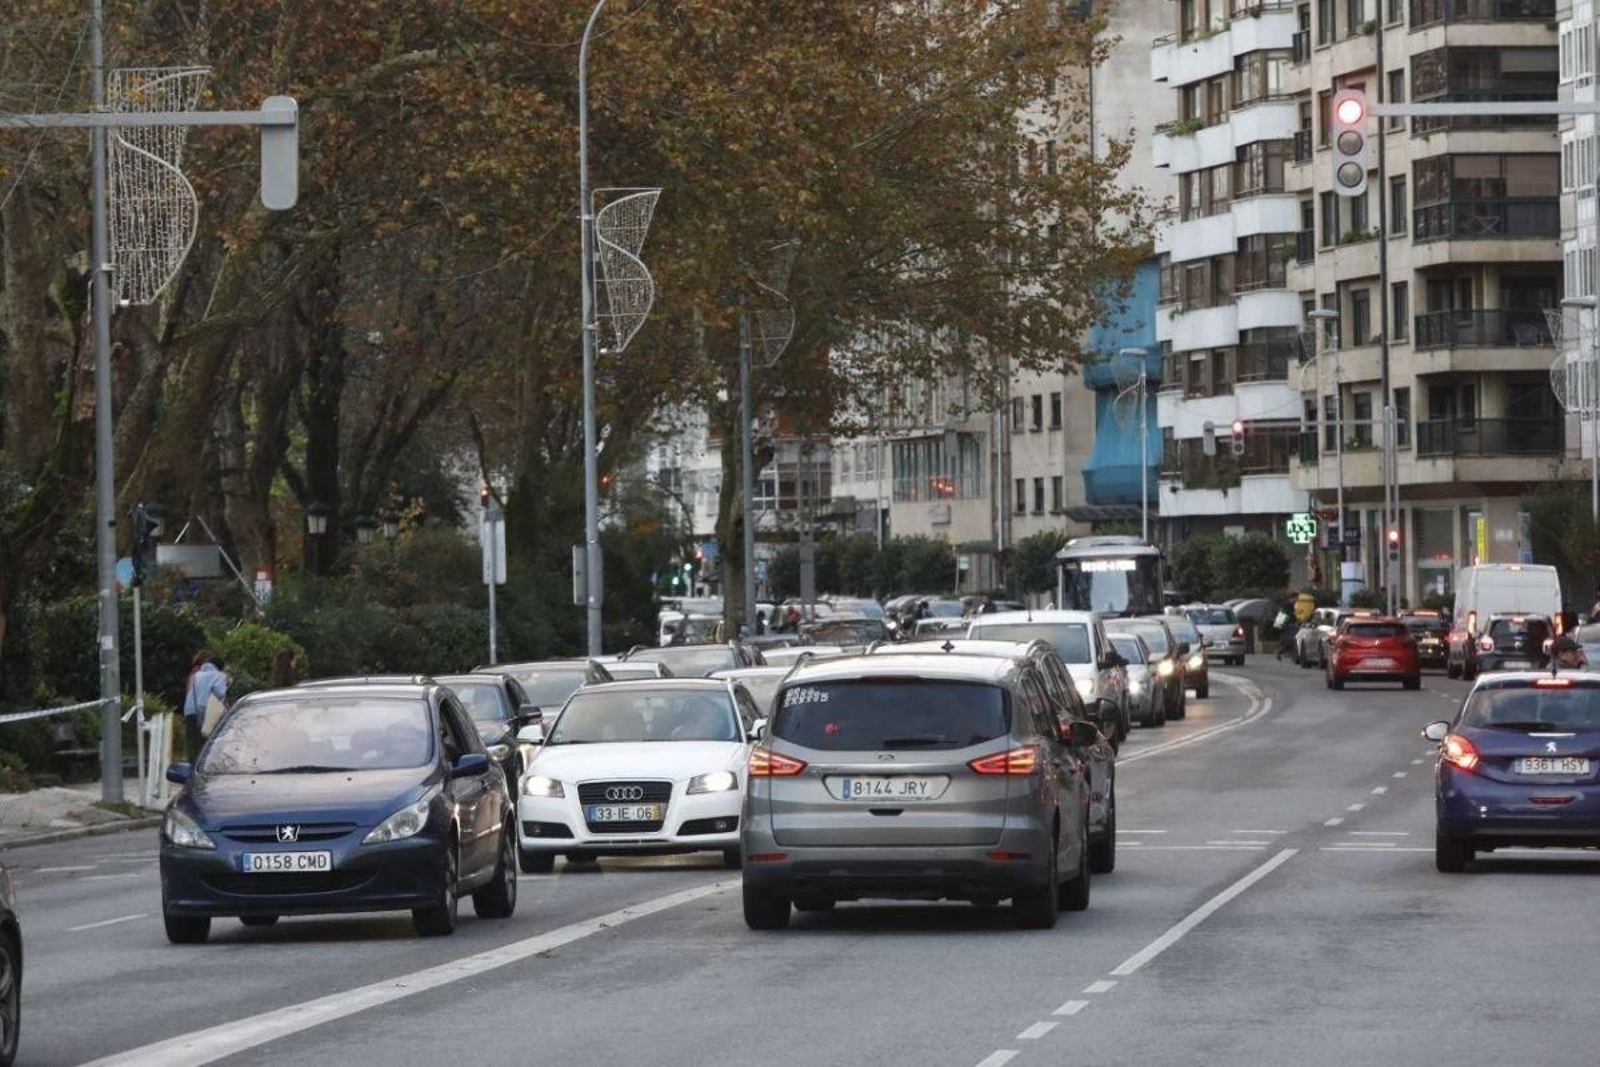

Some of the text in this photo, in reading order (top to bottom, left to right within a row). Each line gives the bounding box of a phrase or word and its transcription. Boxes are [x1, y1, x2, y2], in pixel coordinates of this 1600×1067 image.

[1524, 758, 1585, 771] 9361 HSY
[853, 781, 927, 795] 8144 JRY
[253, 854, 327, 870] 0158 CMD
